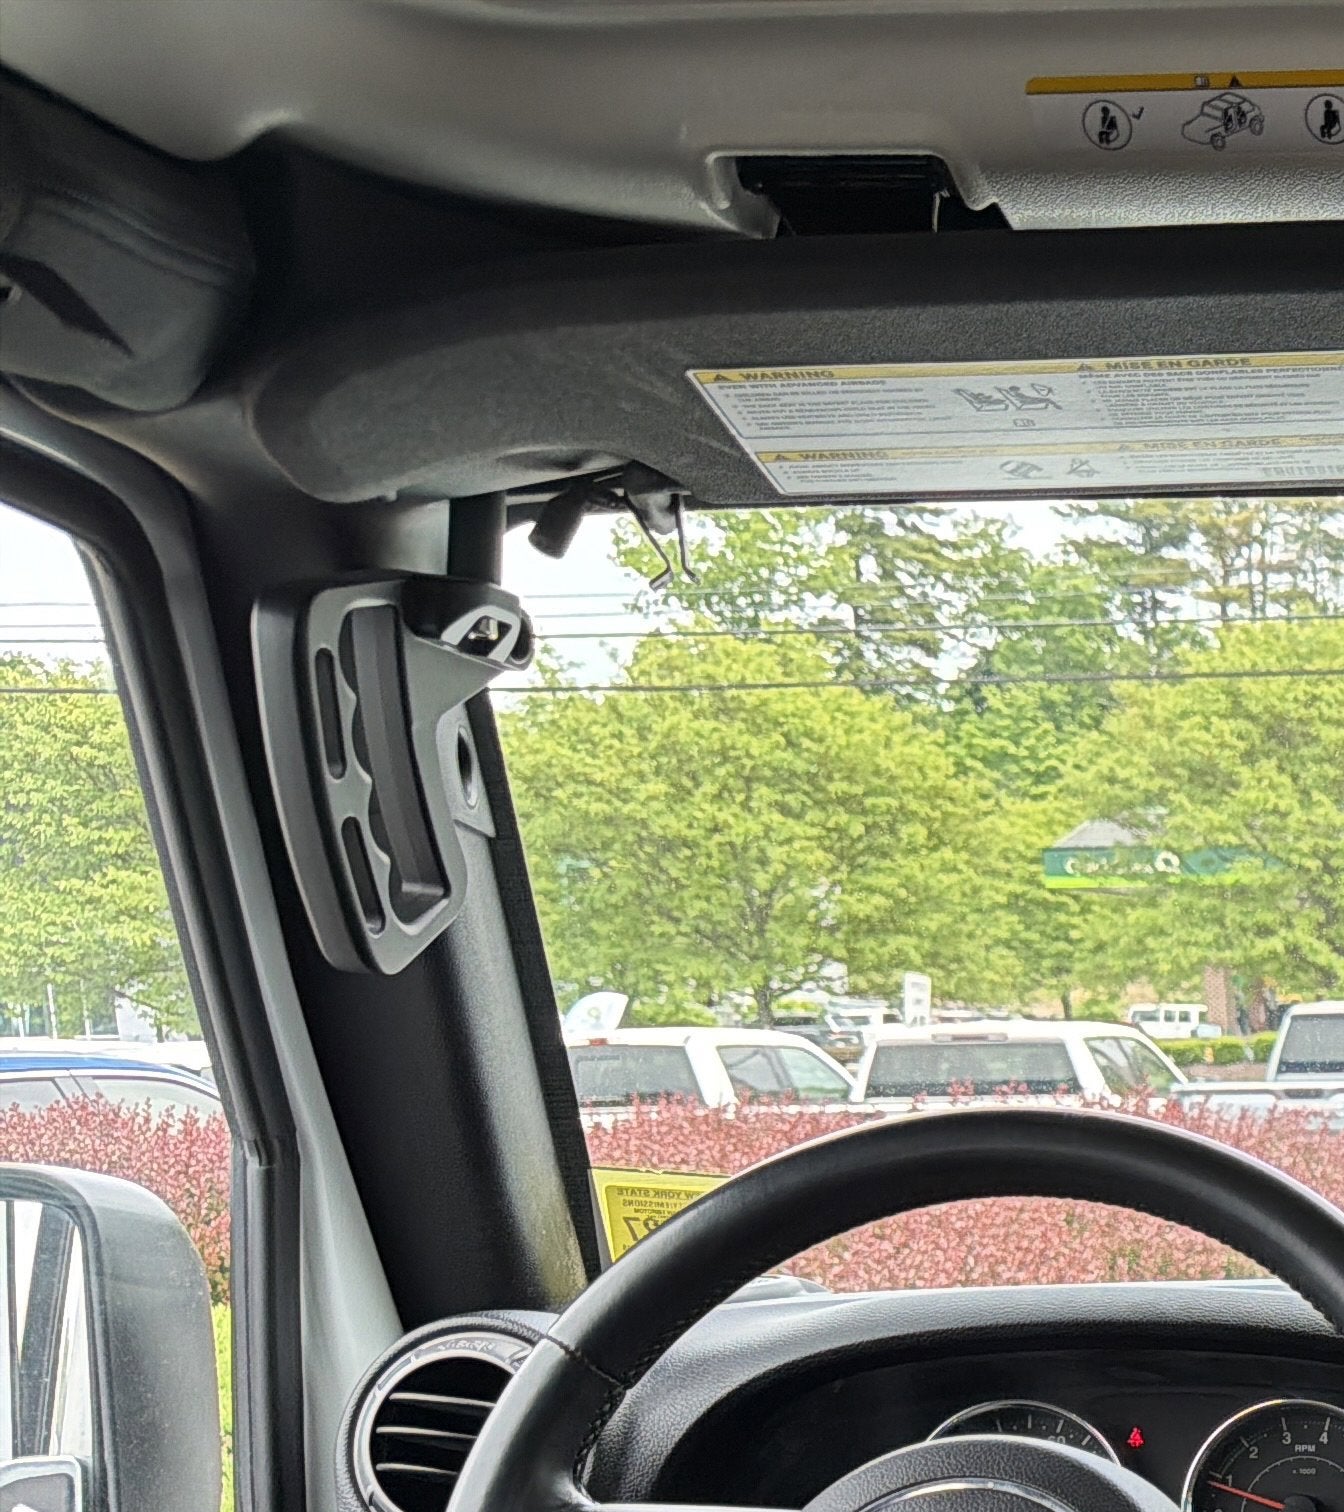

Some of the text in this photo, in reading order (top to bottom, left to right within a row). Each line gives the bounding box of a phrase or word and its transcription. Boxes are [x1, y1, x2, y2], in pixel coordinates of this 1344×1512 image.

[1105, 357, 1251, 370] MISE EN GARDE
[739, 371, 835, 381] WARNING
[1143, 441, 1186, 451] MISE
[1221, 438, 1283, 448] GARDE
[800, 451, 889, 460] WARNING
[1281, 1431, 1292, 1445] 3
[1318, 1431, 1329, 1445] 4
[1248, 1446, 1259, 1459] 2
[1294, 1444, 1316, 1453] RPM
[1226, 1474, 1233, 1486] 1
